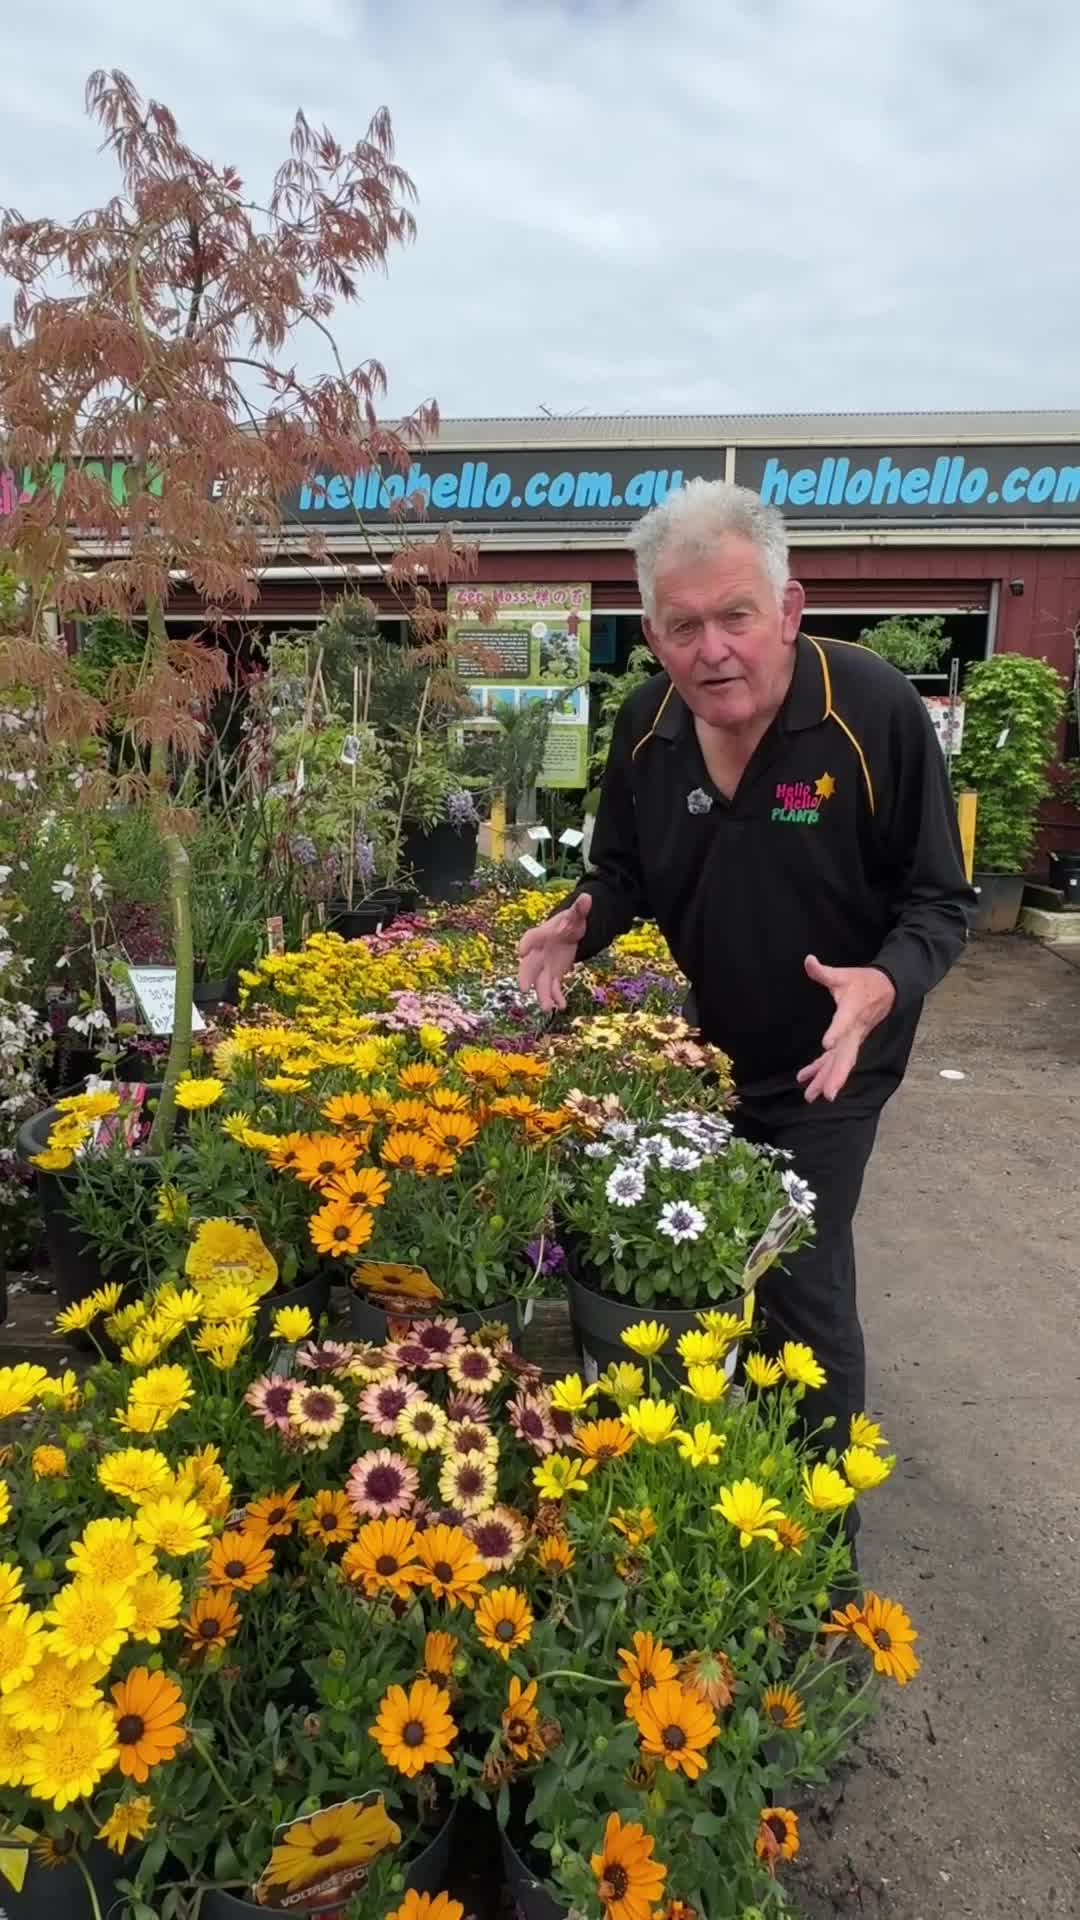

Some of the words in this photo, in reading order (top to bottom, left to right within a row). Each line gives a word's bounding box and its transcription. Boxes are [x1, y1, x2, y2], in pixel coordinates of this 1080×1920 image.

[760, 456, 1080, 505] hellohello.com
[776, 782, 811, 798] Hello
[783, 796, 818, 810] Hello
